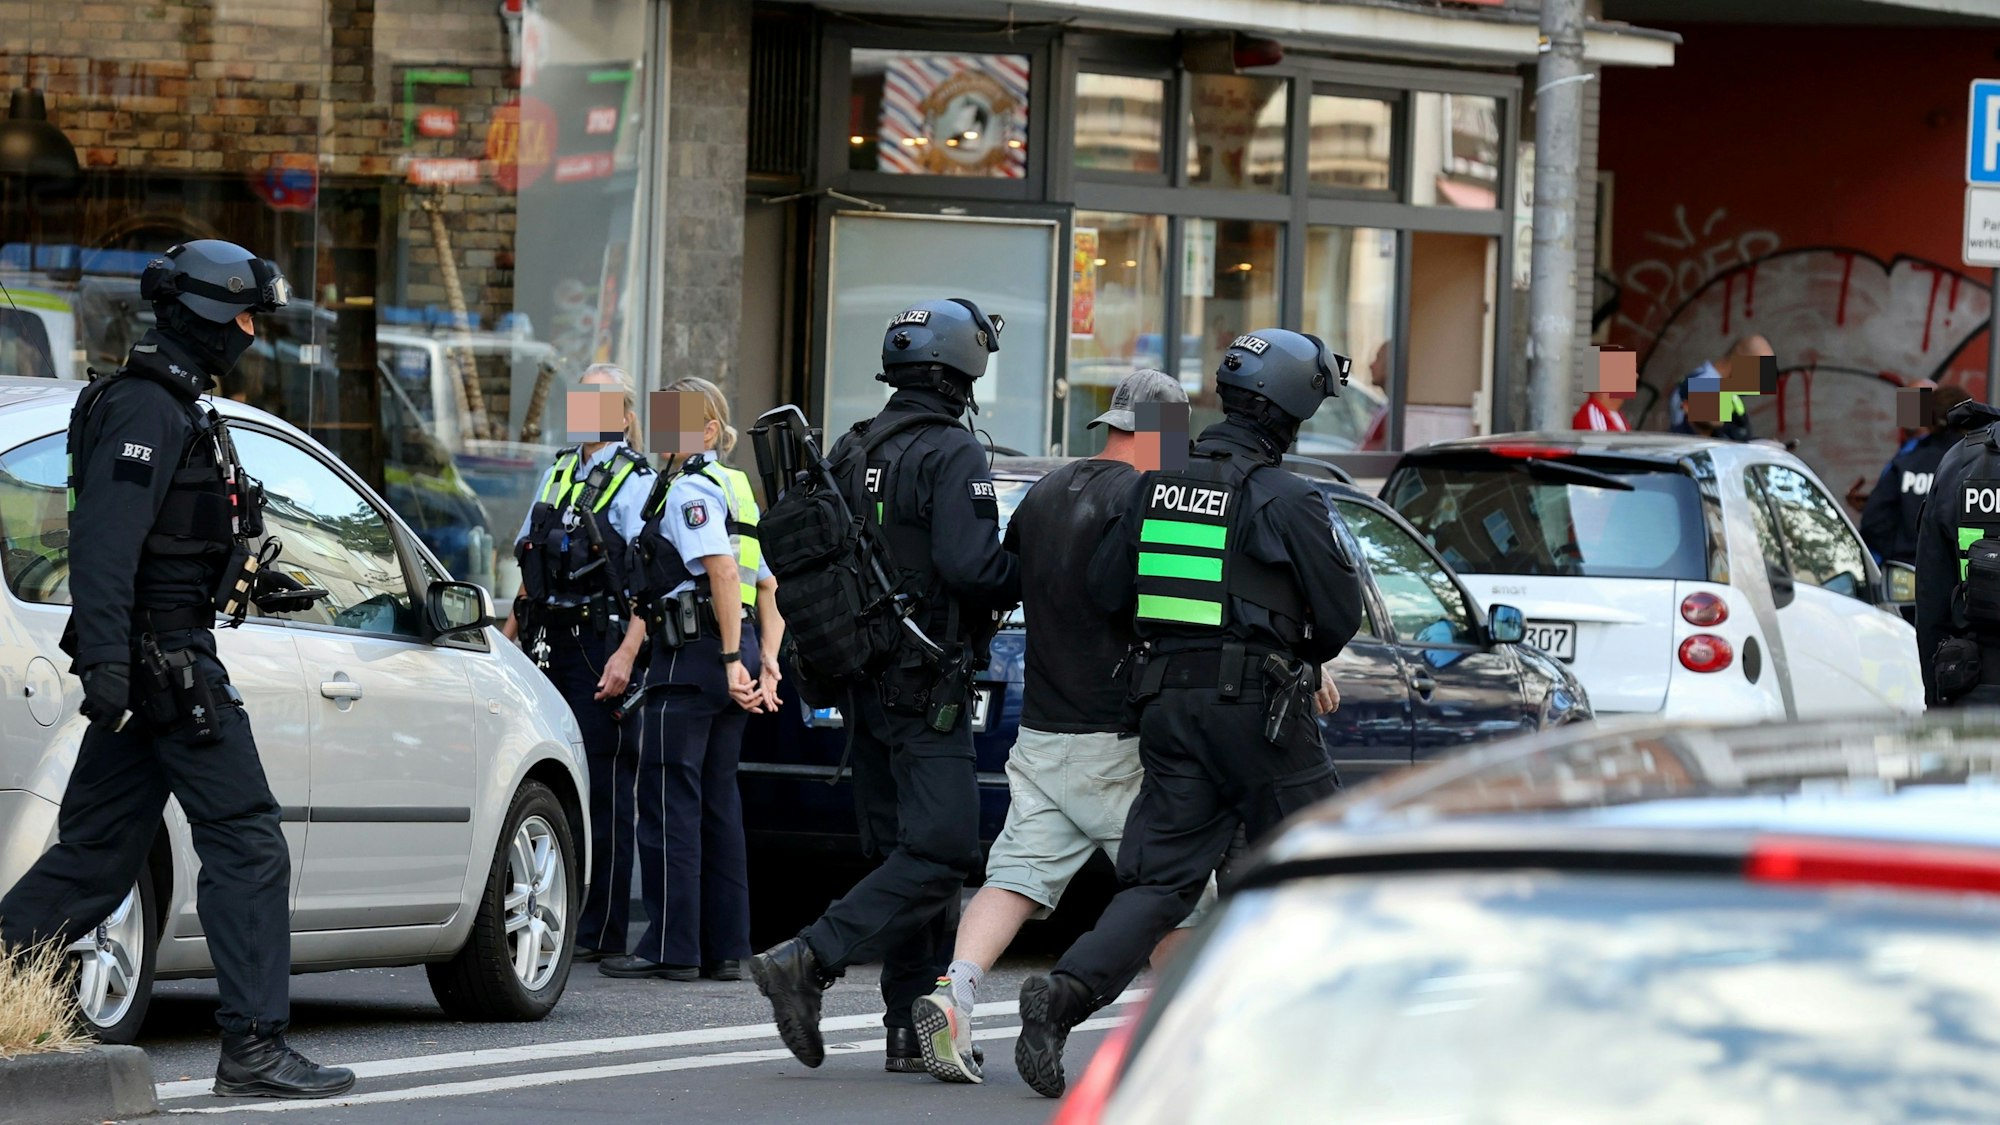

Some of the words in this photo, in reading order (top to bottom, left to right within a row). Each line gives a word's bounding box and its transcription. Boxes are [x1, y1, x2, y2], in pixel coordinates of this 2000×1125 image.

[1230, 335, 1269, 354] POLIZEI
[121, 442, 153, 462] BFE
[971, 482, 994, 497] BFE
[1151, 484, 1229, 517] POLIZEI
